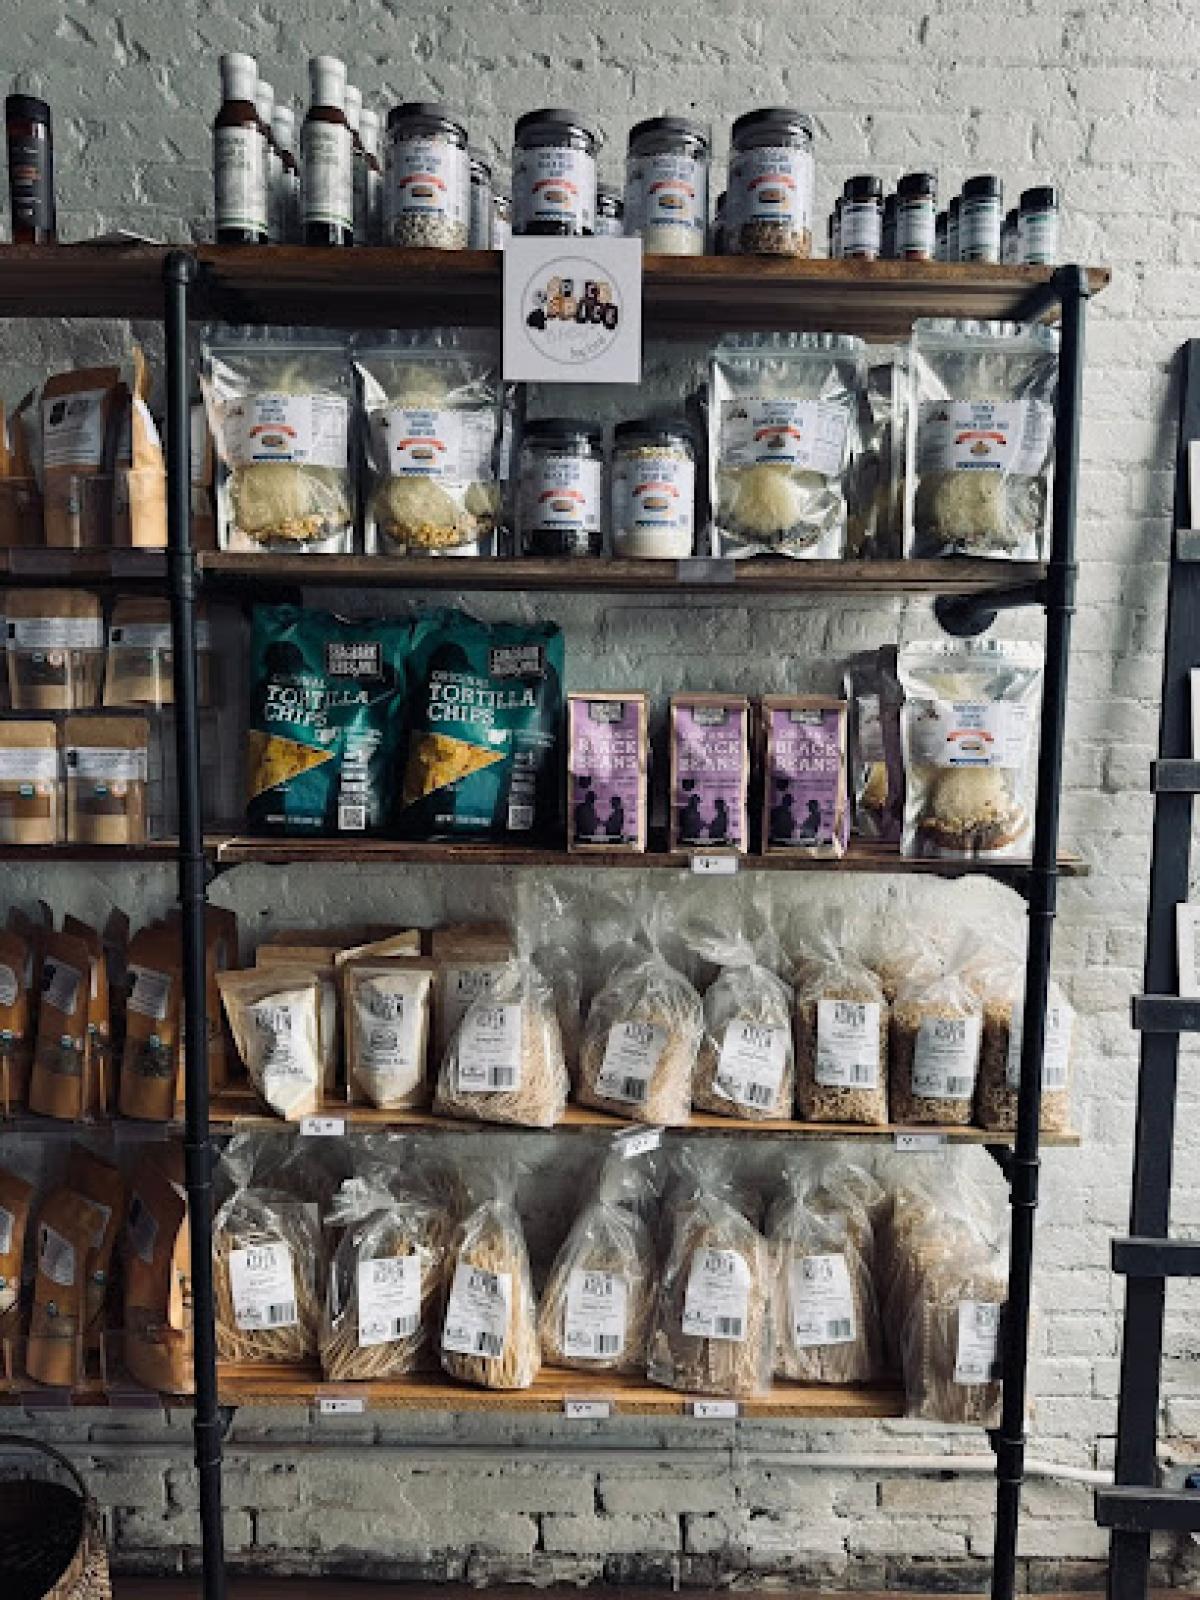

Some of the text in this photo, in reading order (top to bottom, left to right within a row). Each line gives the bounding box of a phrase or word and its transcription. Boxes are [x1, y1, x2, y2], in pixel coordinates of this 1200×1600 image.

[272, 673, 327, 689] OINAL
[266, 684, 369, 709] TORTILLA
[428, 682, 537, 710] TORTILLA
[264, 702, 328, 728] CHIPS
[427, 702, 495, 728] CHIPS
[776, 741, 839, 757] BLACK
[576, 754, 637, 769] BEANS
[679, 756, 741, 772] BEANS
[776, 755, 839, 772] BEANS
